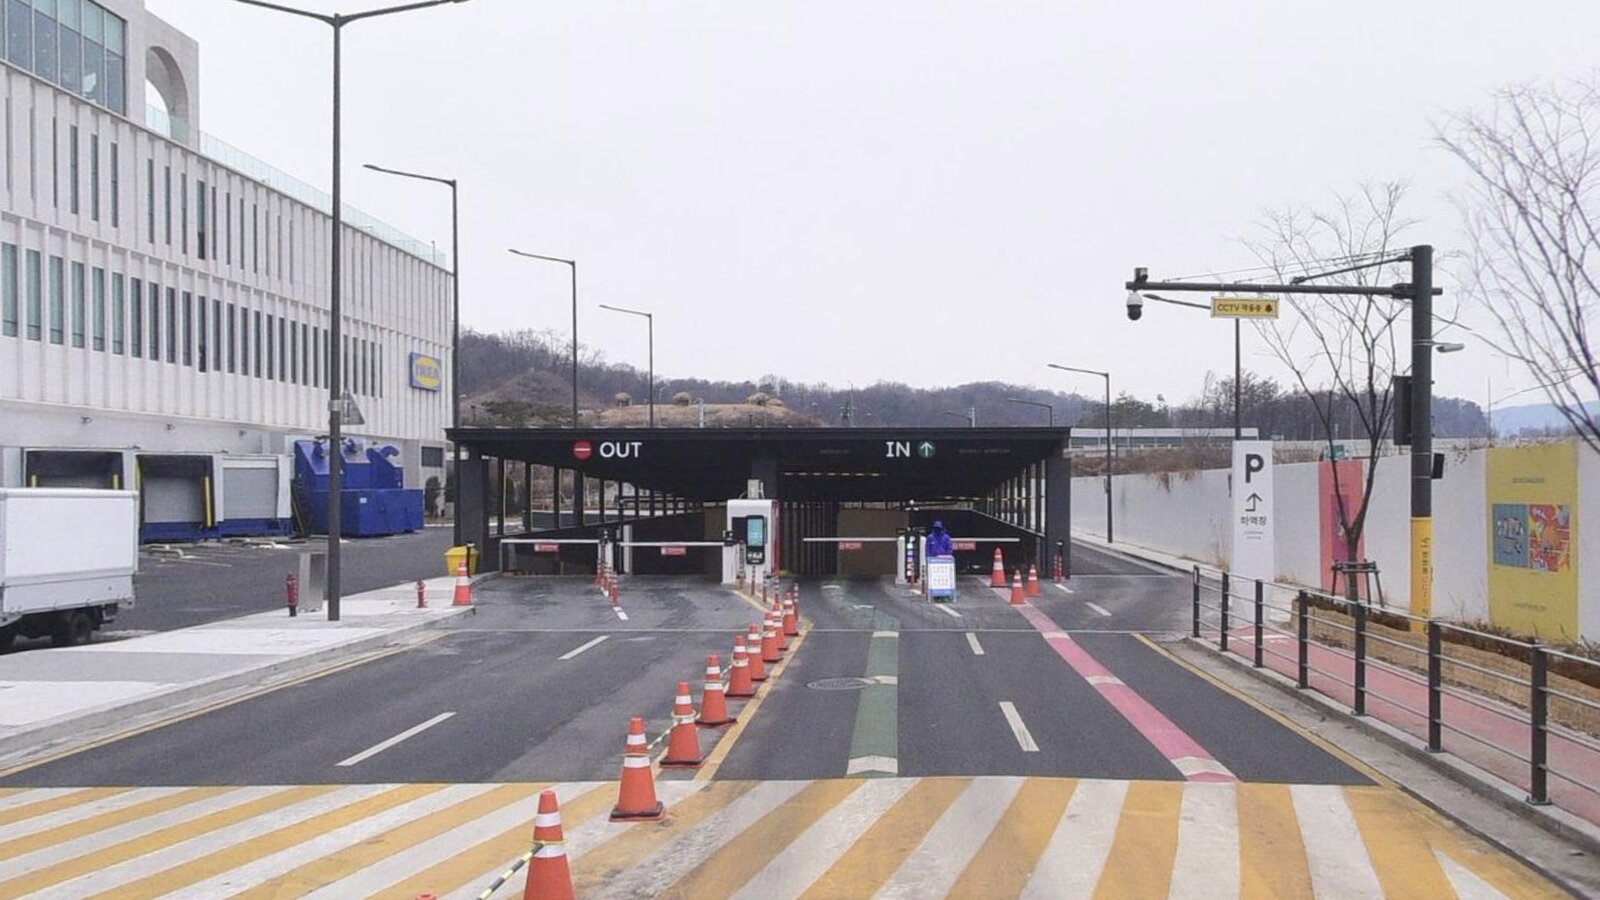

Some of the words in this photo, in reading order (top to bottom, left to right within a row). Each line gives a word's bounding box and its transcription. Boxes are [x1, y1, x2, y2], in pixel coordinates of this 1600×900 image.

[1217, 303, 1239, 313] CCTV
[415, 364, 440, 379] IKEA
[600, 442, 642, 458] OUT
[885, 442, 910, 458] IN
[1245, 453, 1264, 483] P
